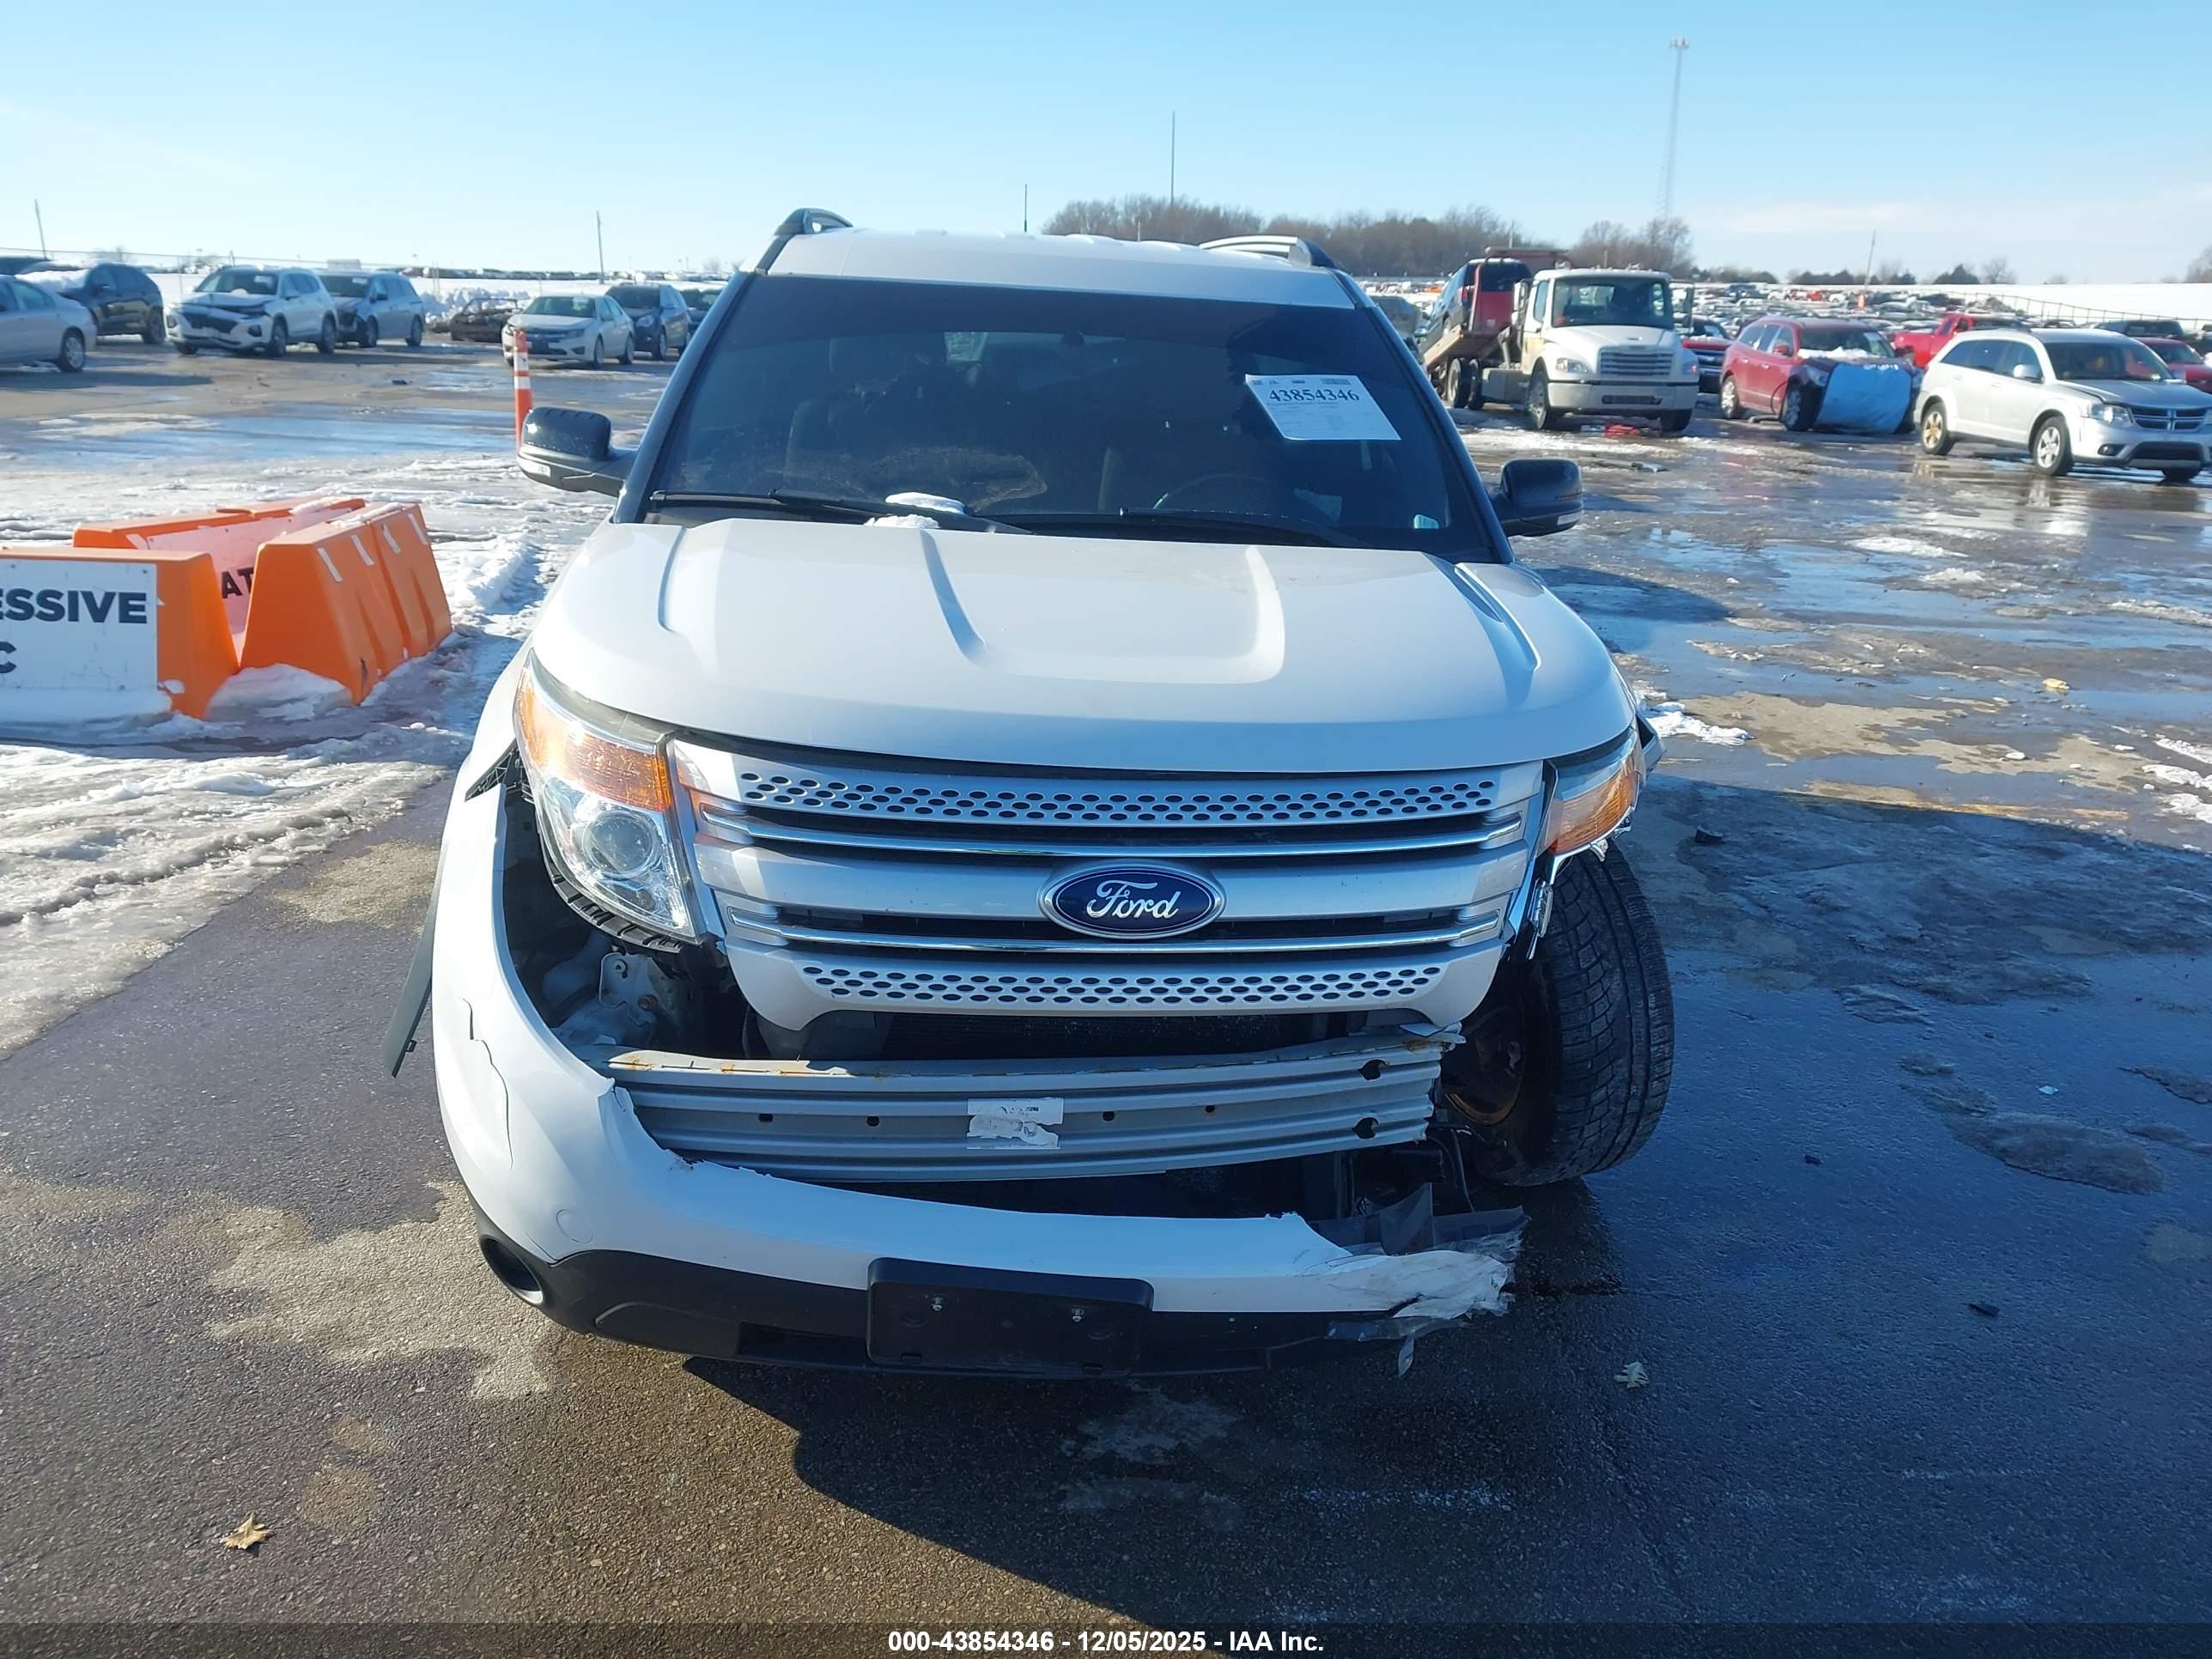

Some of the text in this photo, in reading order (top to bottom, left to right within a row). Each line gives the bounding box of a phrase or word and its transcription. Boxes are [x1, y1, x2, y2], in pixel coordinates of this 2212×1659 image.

[1269, 389, 1359, 402] 43854346
[221, 567, 255, 599] AT
[0, 587, 147, 624] SSIVE
[1086, 879, 1182, 919] Ford
